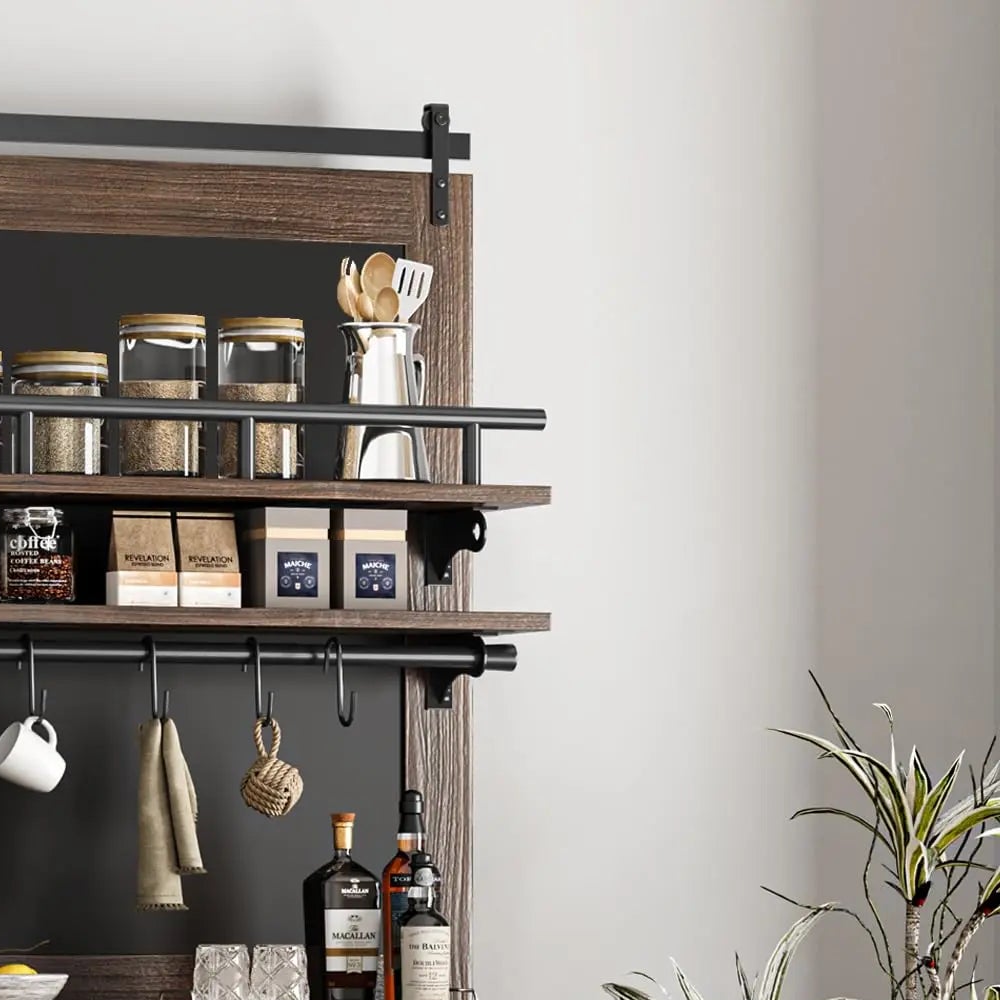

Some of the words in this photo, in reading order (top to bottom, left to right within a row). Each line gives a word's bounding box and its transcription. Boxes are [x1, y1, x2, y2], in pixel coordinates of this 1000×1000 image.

[9, 535, 57, 549] coffee
[125, 554, 170, 562] REVELATION
[188, 555, 233, 564] REVELATION
[332, 932, 377, 940] MACALLAN
